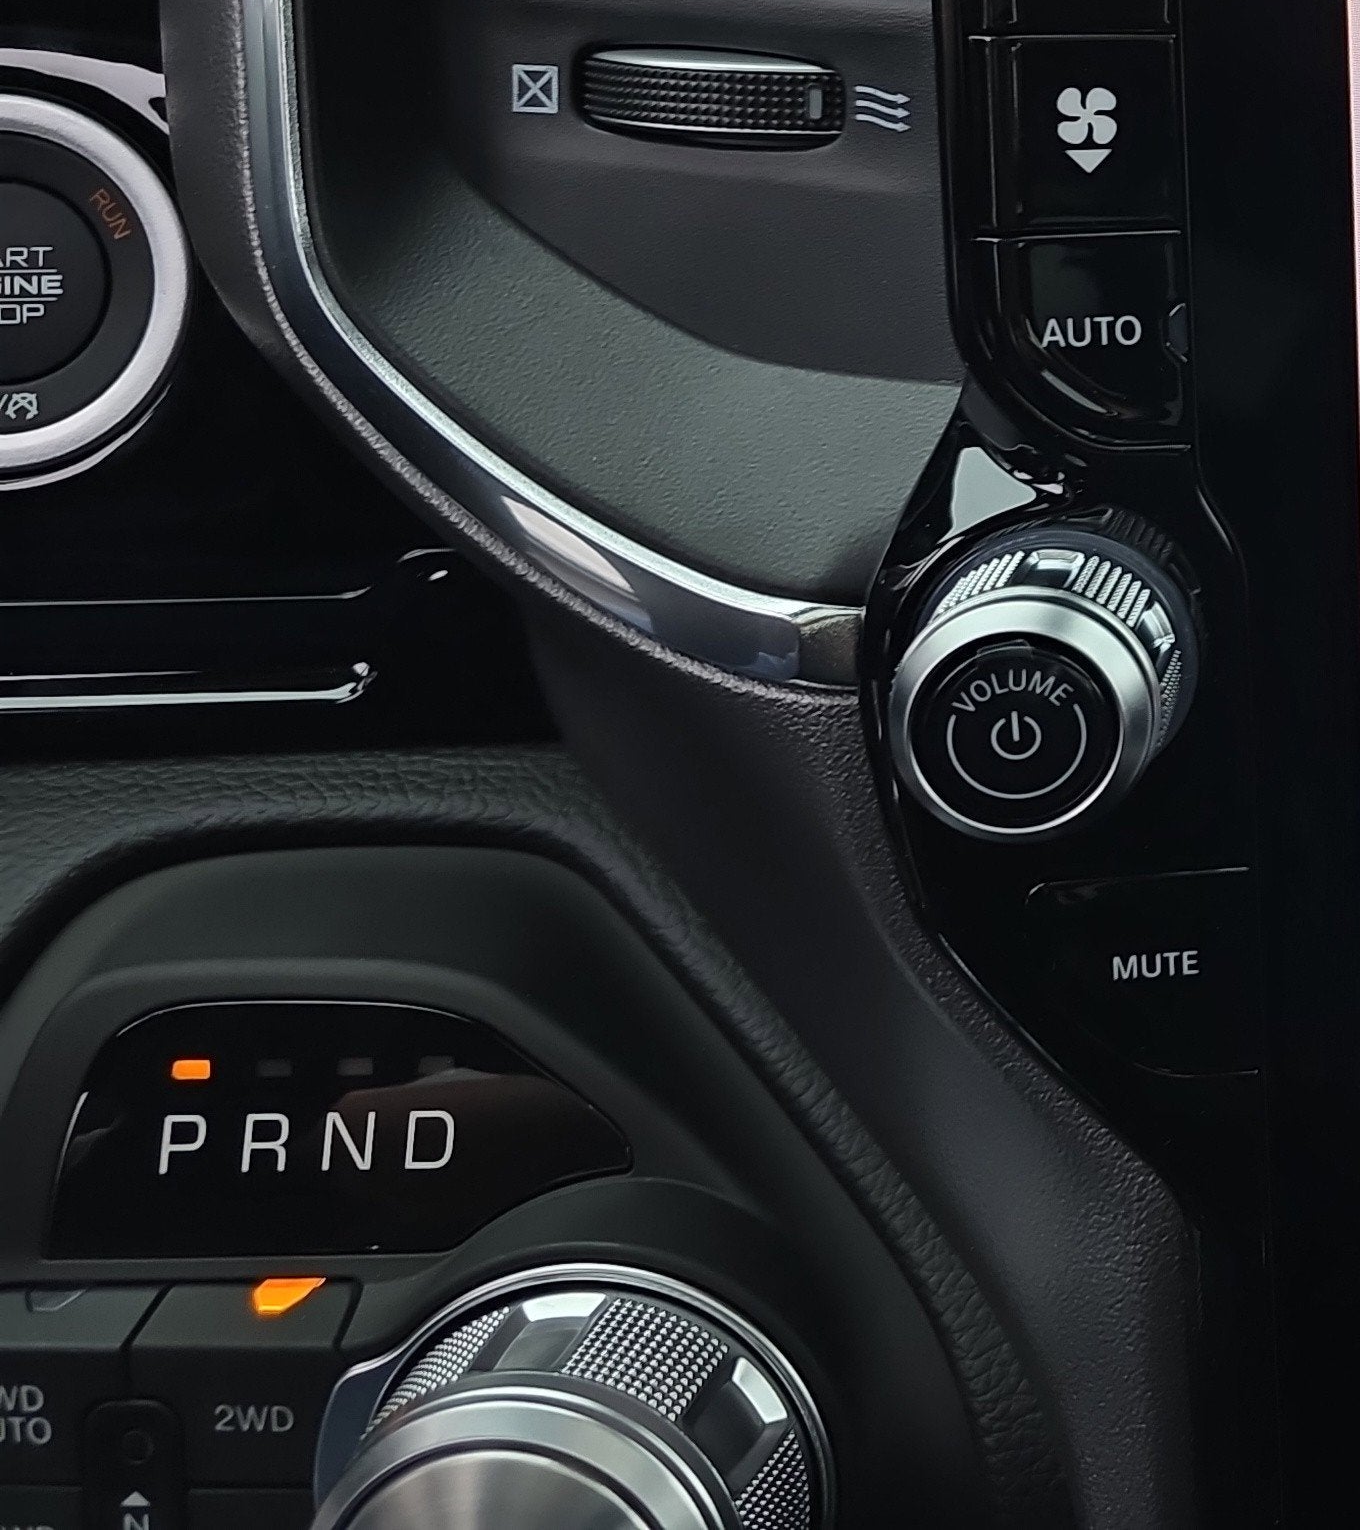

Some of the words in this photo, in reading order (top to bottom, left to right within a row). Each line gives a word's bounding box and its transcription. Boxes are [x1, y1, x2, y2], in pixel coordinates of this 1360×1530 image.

[89, 188, 132, 241] RUN
[0, 246, 54, 268] RT
[0, 274, 64, 296] INE
[1042, 315, 1142, 348] AUTO
[952, 668, 1074, 716] VOLUME
[1112, 950, 1200, 981] MUTE
[158, 1114, 207, 1175] P
[241, 1112, 290, 1173] R
[321, 1111, 376, 1172] N
[404, 1109, 455, 1170] D
[214, 1404, 294, 1432] 2WD
